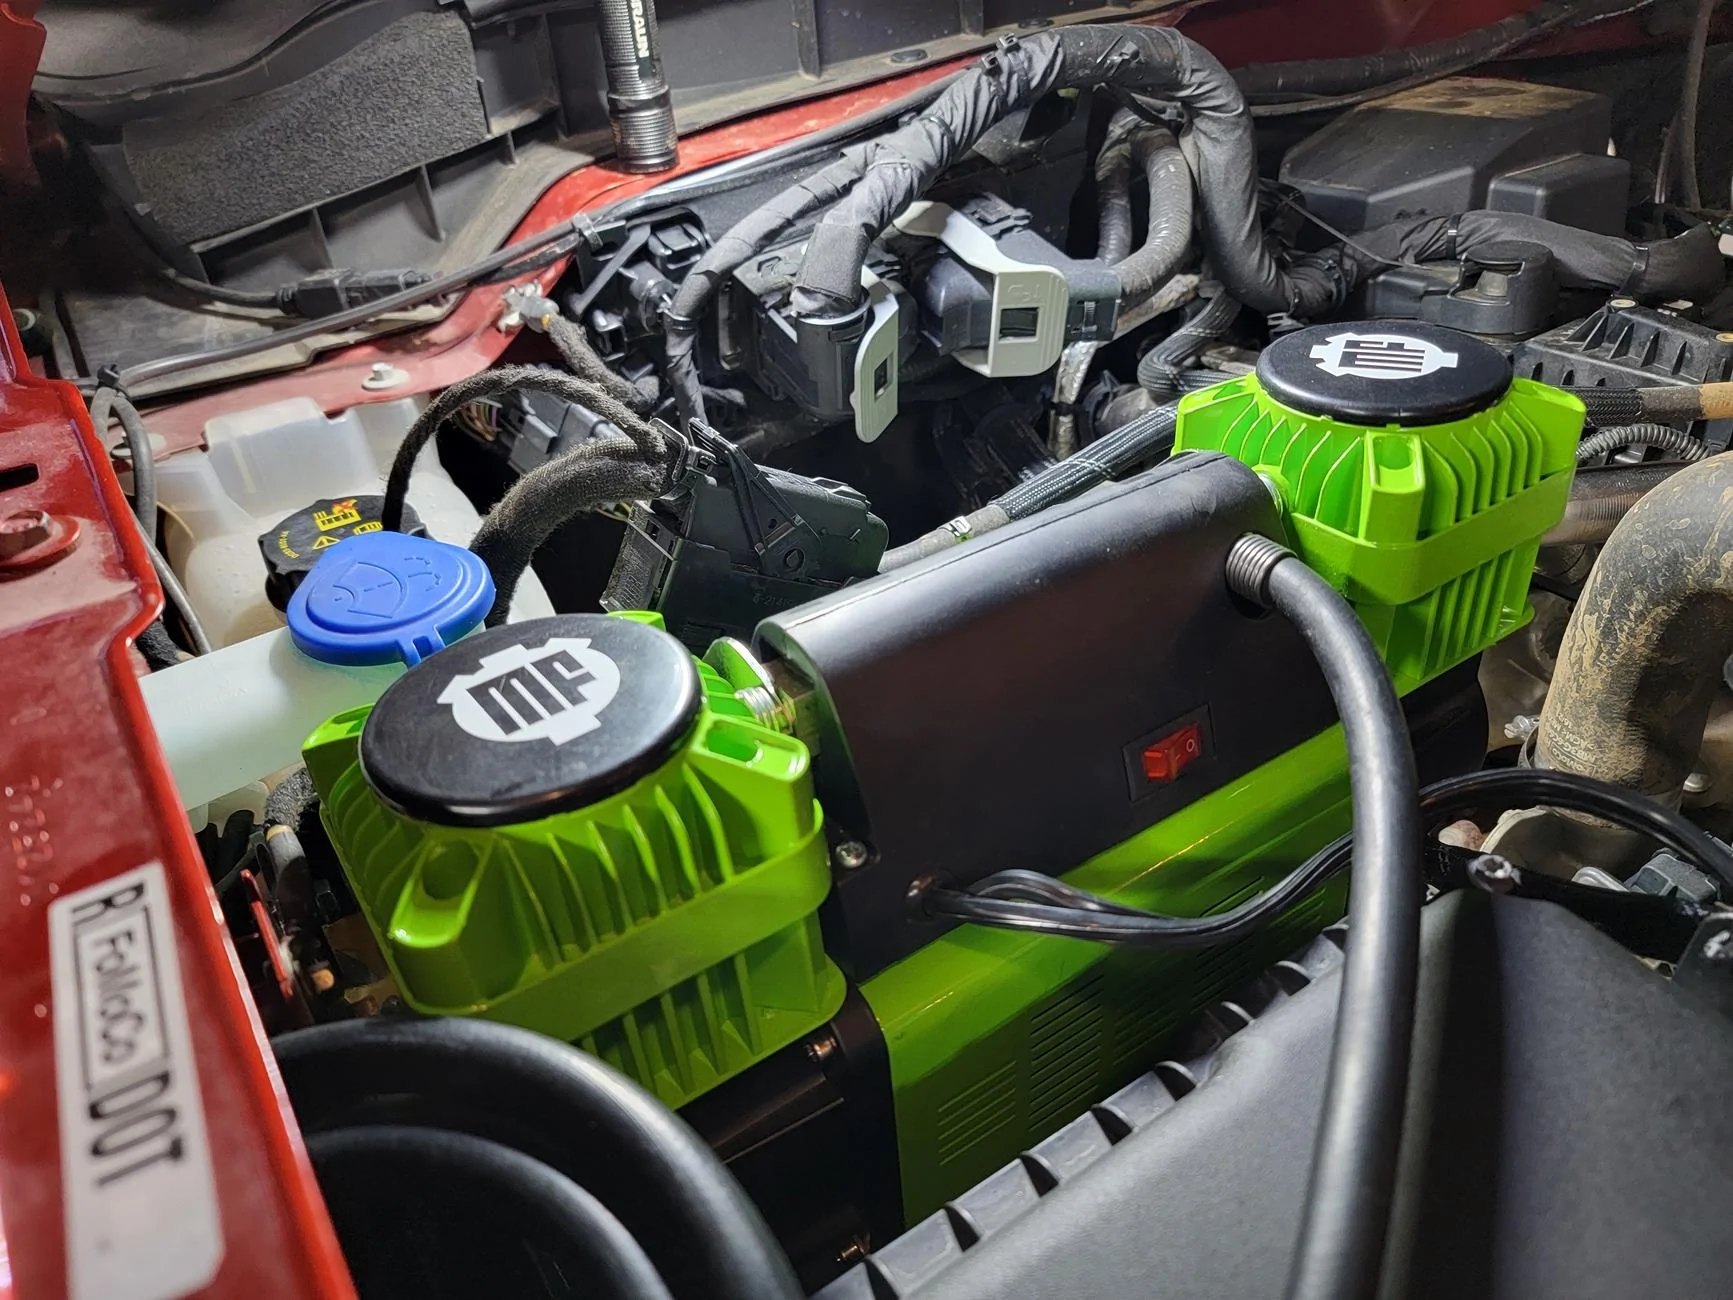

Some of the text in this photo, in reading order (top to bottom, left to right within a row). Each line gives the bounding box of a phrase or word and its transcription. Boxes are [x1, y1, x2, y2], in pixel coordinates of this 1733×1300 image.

[630, 0, 650, 58] RAUN
[466, 649, 597, 736] MF
[71, 883, 144, 927] R
[88, 1070, 183, 1187] DOT
